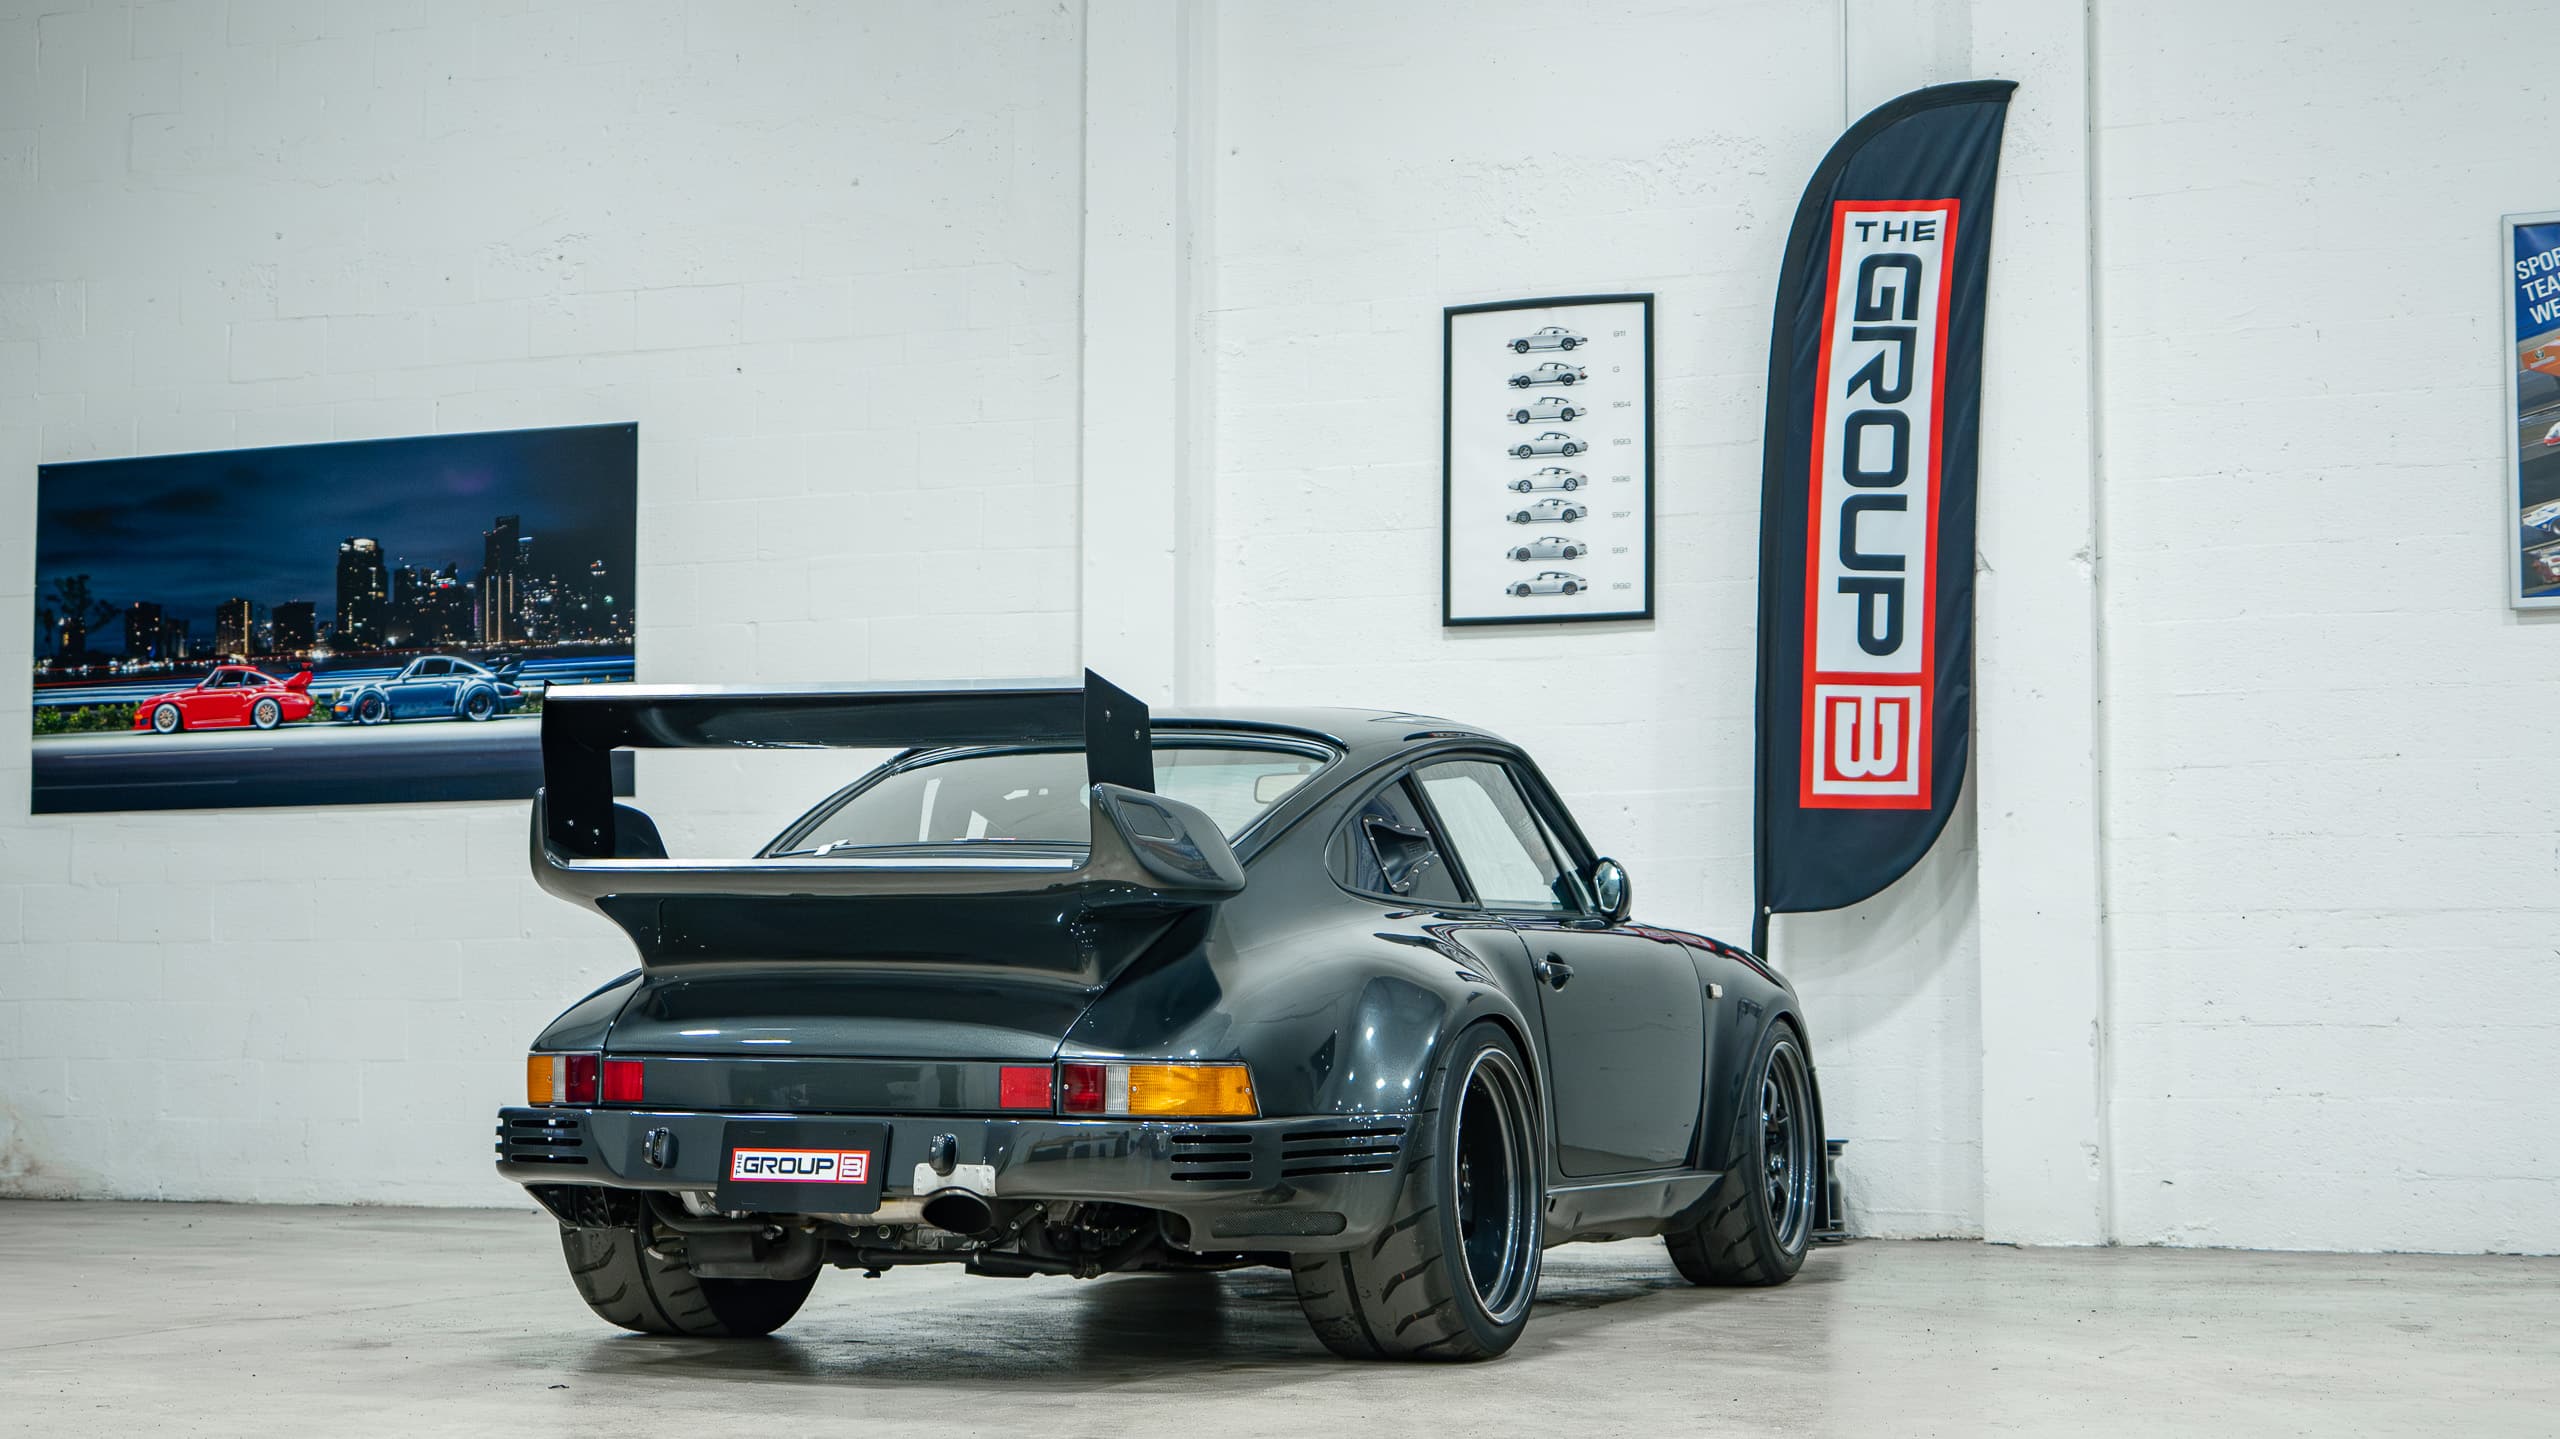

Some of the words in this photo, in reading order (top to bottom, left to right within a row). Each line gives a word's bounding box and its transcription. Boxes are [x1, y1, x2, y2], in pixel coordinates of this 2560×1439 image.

[1855, 219, 1937, 242] THE
[2521, 271, 2560, 302] TEA
[1612, 329, 1627, 338] 911
[1612, 400, 1632, 409] 964
[1837, 252, 1923, 657] GROUP
[1611, 510, 1632, 519] 997
[735, 1153, 743, 1176] THE
[743, 1156, 835, 1175] GROUP
